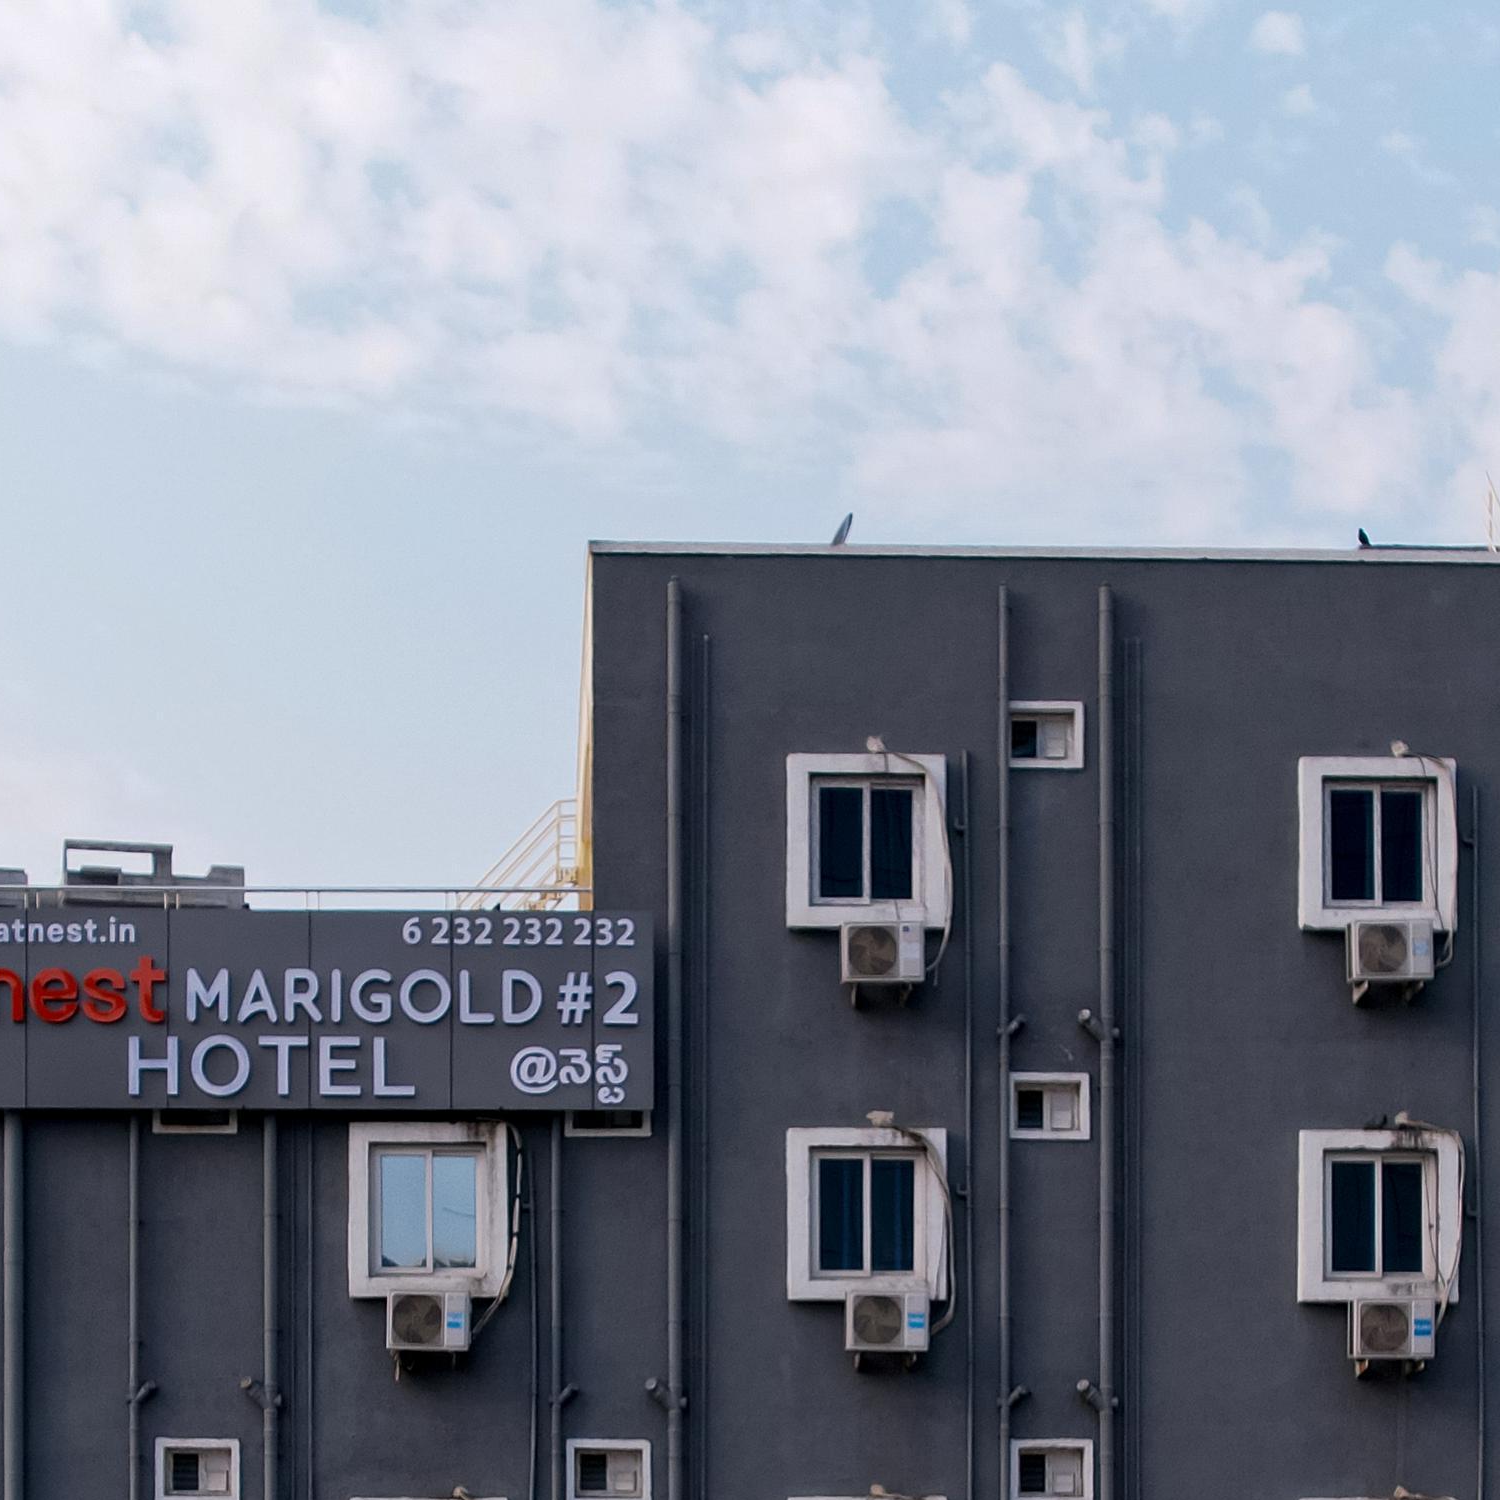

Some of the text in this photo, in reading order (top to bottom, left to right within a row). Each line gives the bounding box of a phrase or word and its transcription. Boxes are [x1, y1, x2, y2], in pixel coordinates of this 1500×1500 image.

[402, 917, 635, 947] 6 232 232 232
[185, 967, 543, 1024] MARIGOLD
[127, 1034, 416, 1097] HOTEL
